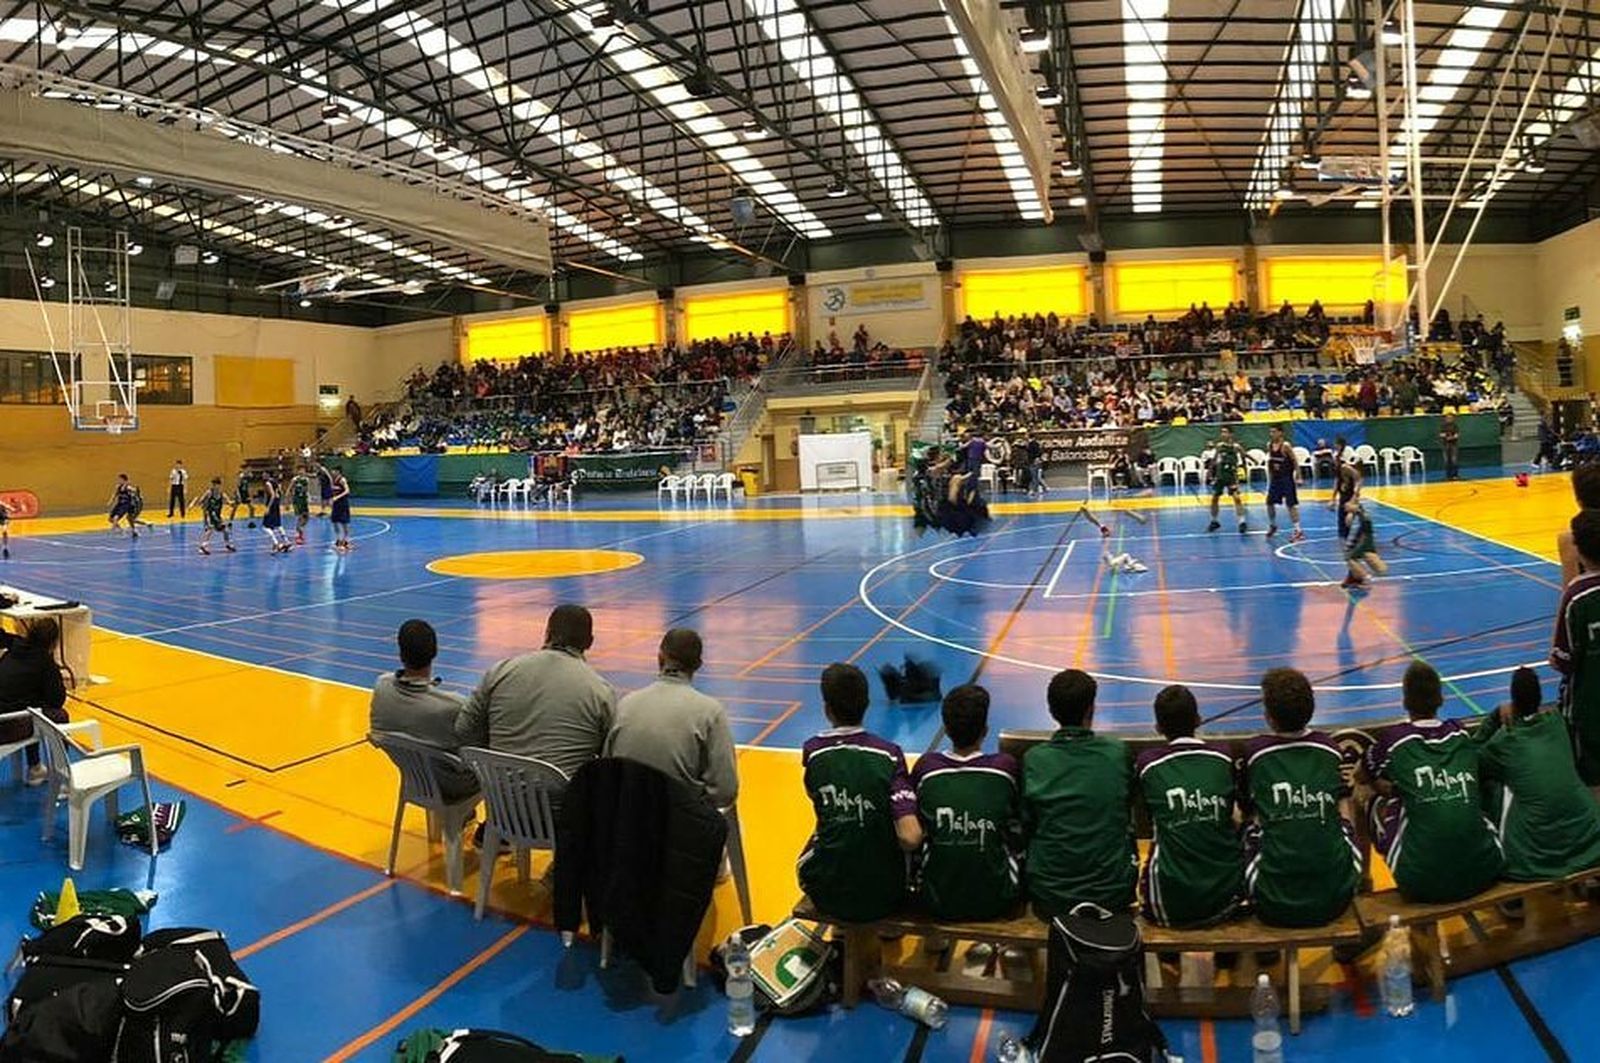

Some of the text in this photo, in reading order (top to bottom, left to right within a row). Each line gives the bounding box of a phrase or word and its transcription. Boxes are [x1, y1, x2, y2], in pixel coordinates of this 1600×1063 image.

[1272, 782, 1335, 825] Málaga
[1413, 765, 1476, 803] Málaga
[1165, 787, 1227, 824] Málaga
[935, 807, 997, 851] Málaga
